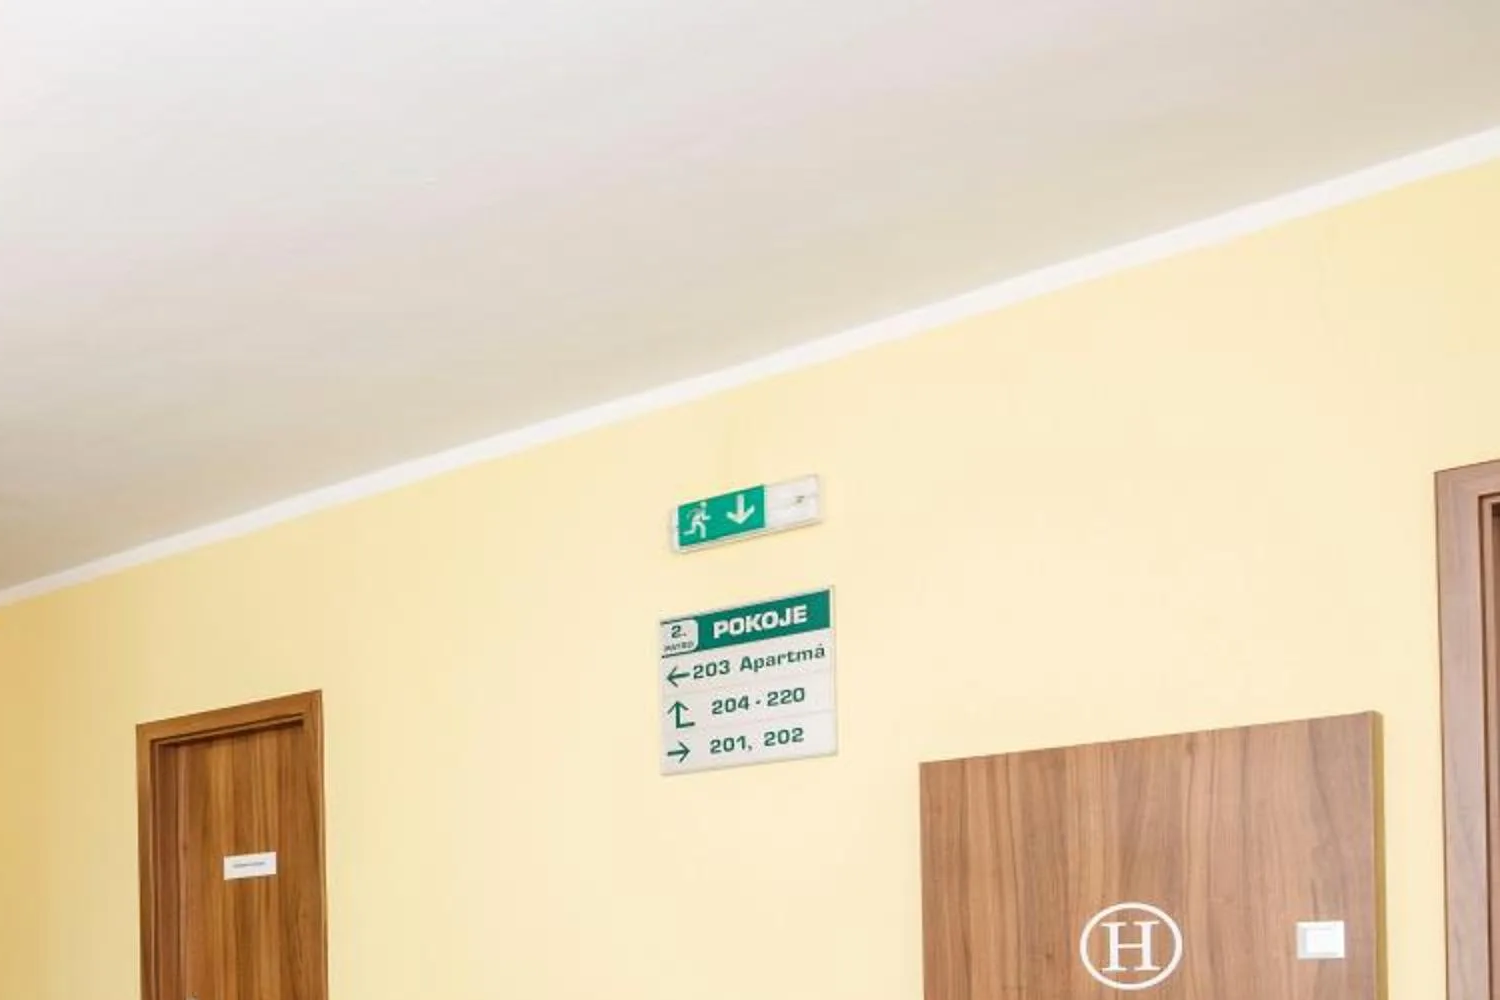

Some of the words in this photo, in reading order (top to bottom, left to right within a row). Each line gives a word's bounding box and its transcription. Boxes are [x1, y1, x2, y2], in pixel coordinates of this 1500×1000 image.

[671, 625, 687, 639] 2.
[713, 605, 808, 639] POKOJE
[693, 660, 731, 679] 203
[740, 643, 825, 673] Apartmá
[711, 696, 750, 715] 204
[767, 688, 805, 708] 220
[710, 736, 752, 754] 201,
[764, 728, 804, 747] 202
[1101, 920, 1161, 972] H
